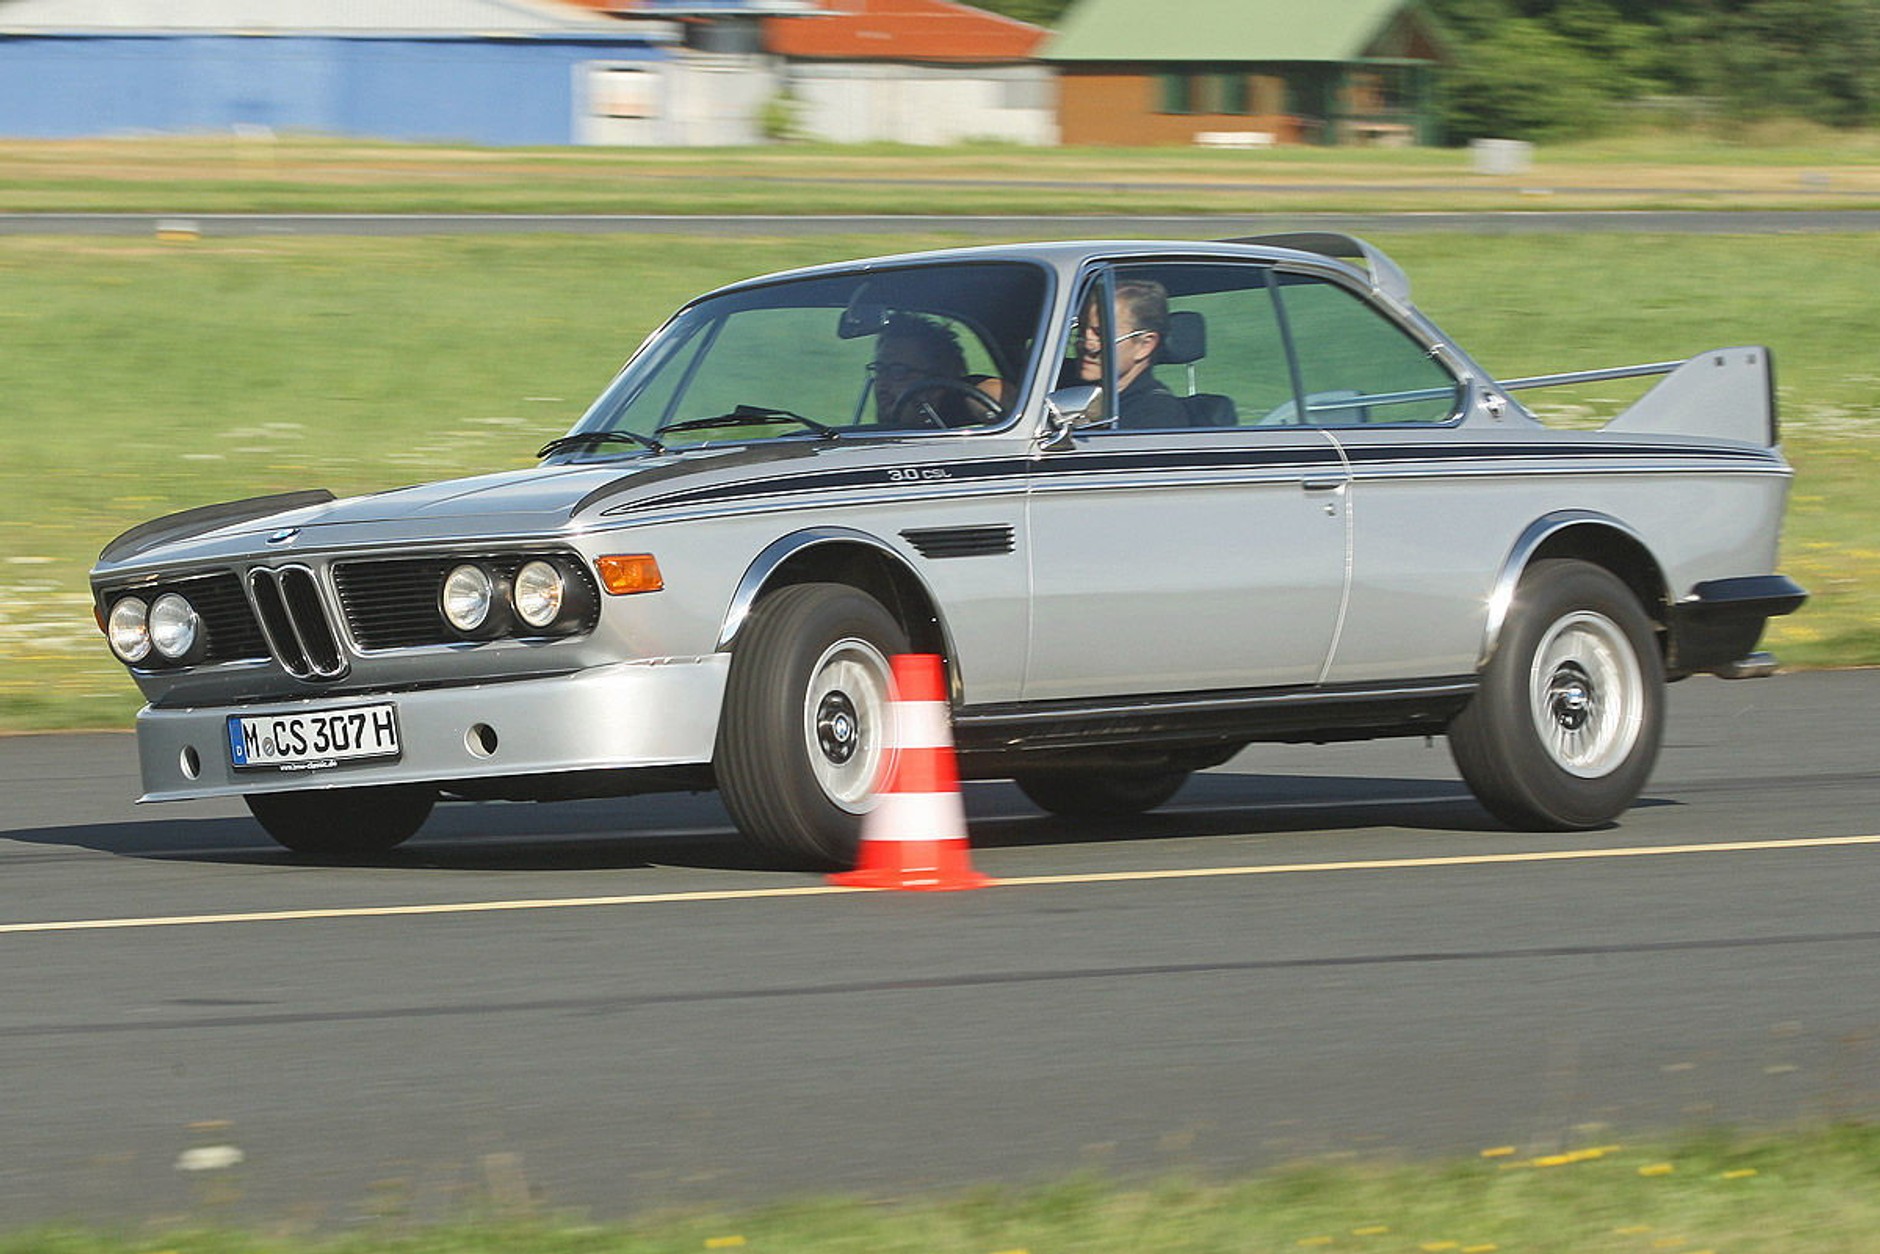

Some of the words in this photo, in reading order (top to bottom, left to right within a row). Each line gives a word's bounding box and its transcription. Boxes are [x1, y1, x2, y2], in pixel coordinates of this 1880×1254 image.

[922, 469, 952, 480] CSL
[243, 722, 260, 758] M
[273, 719, 308, 756] CS
[310, 712, 366, 752] 307
[372, 710, 395, 746] H
